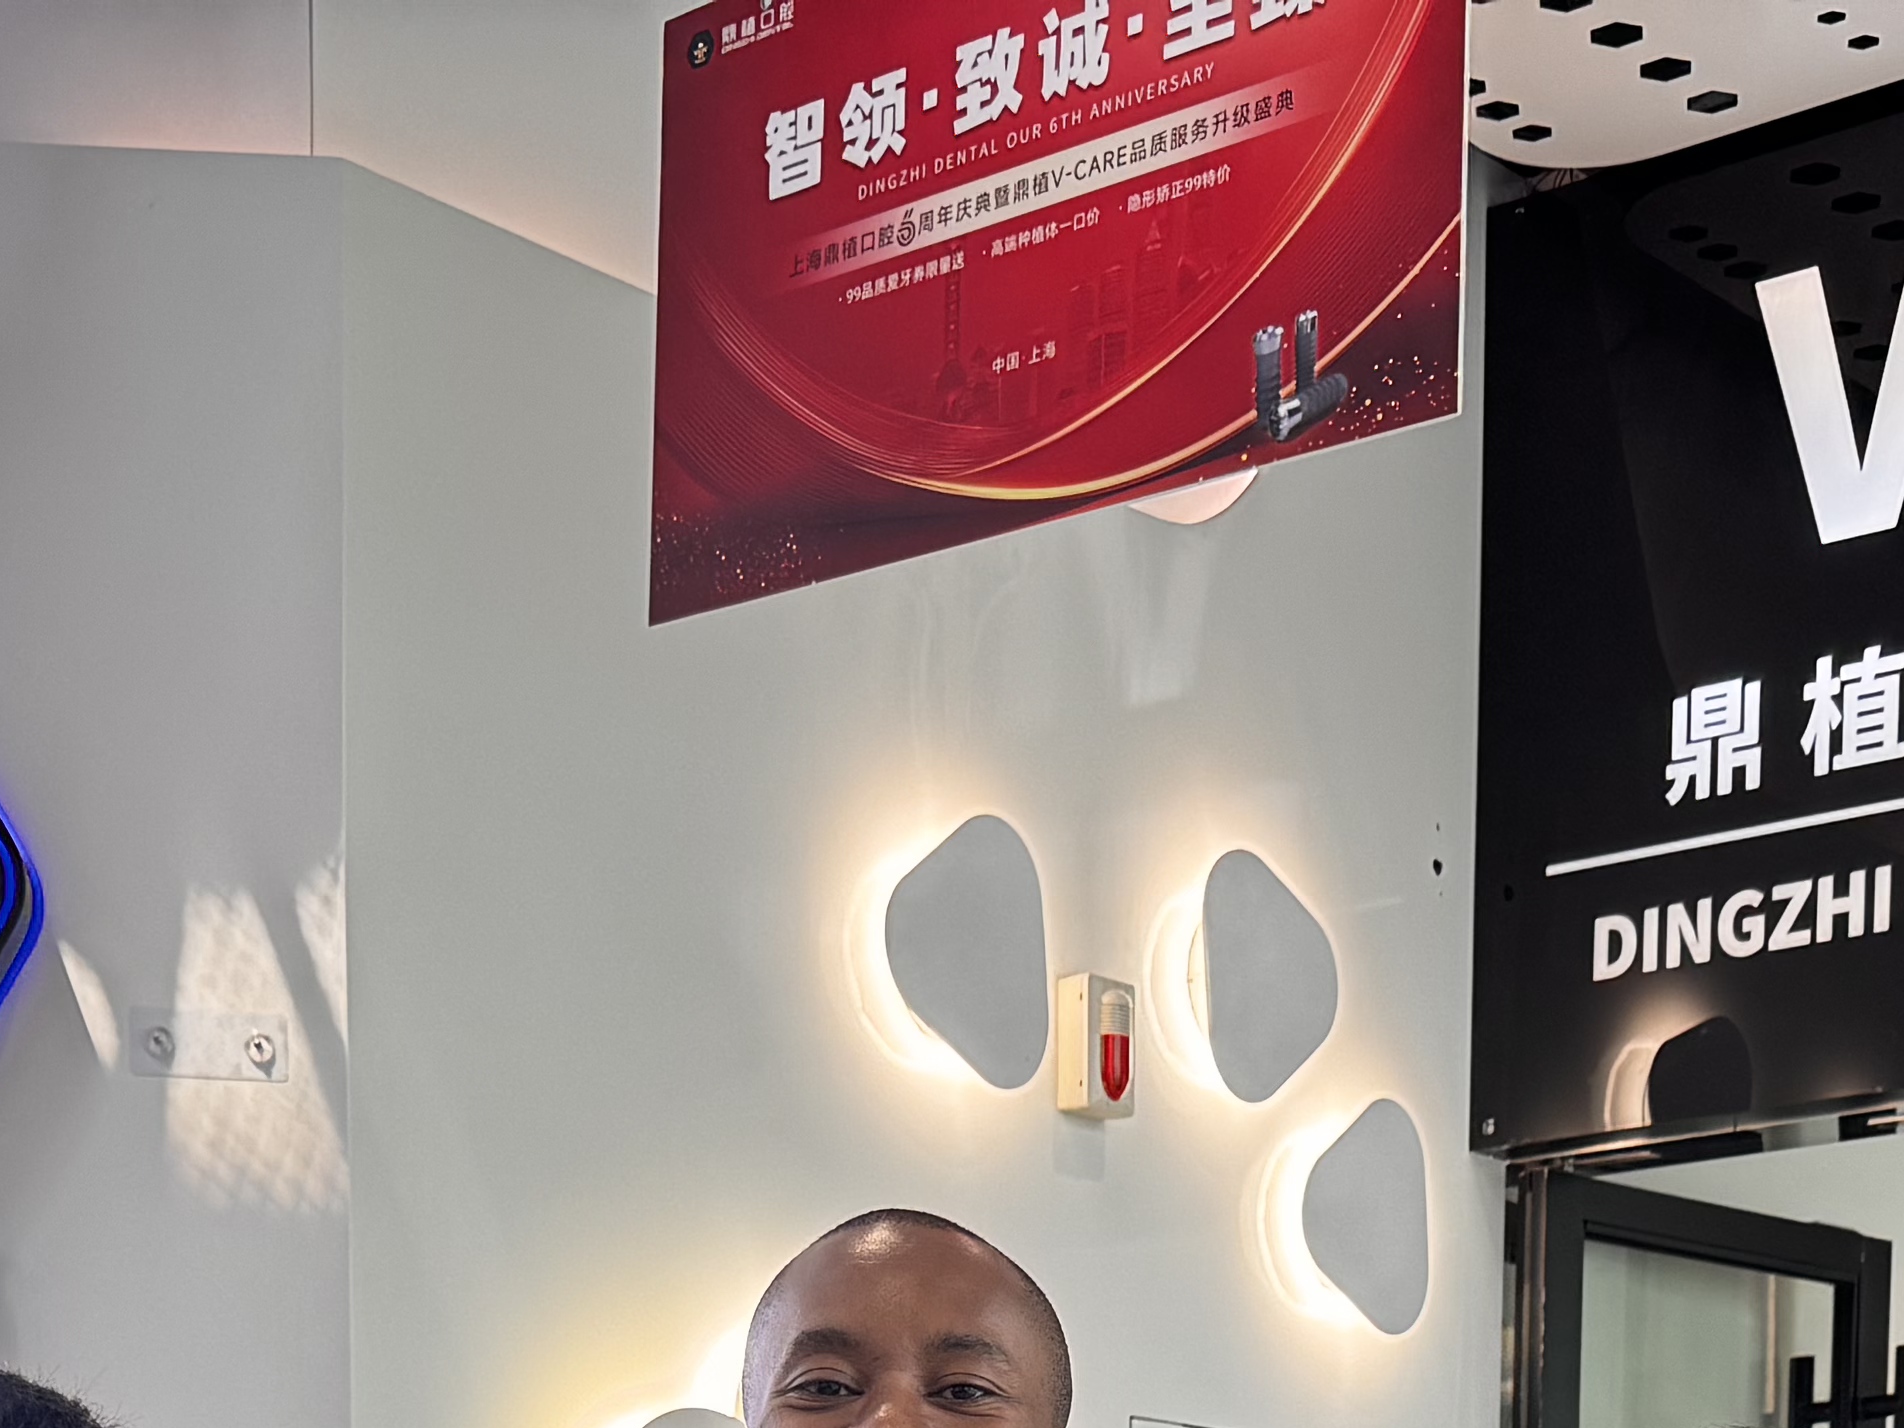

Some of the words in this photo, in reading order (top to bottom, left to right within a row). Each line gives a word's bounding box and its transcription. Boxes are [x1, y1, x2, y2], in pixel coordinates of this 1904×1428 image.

[858, 164, 927, 201] DINGZHI
[934, 142, 999, 173] DENTAL
[1006, 121, 1043, 150] OUR
[1049, 108, 1082, 135] 6TH
[1090, 61, 1215, 119] ANNIVERSARY
[1591, 870, 1895, 983] DINGZHI
